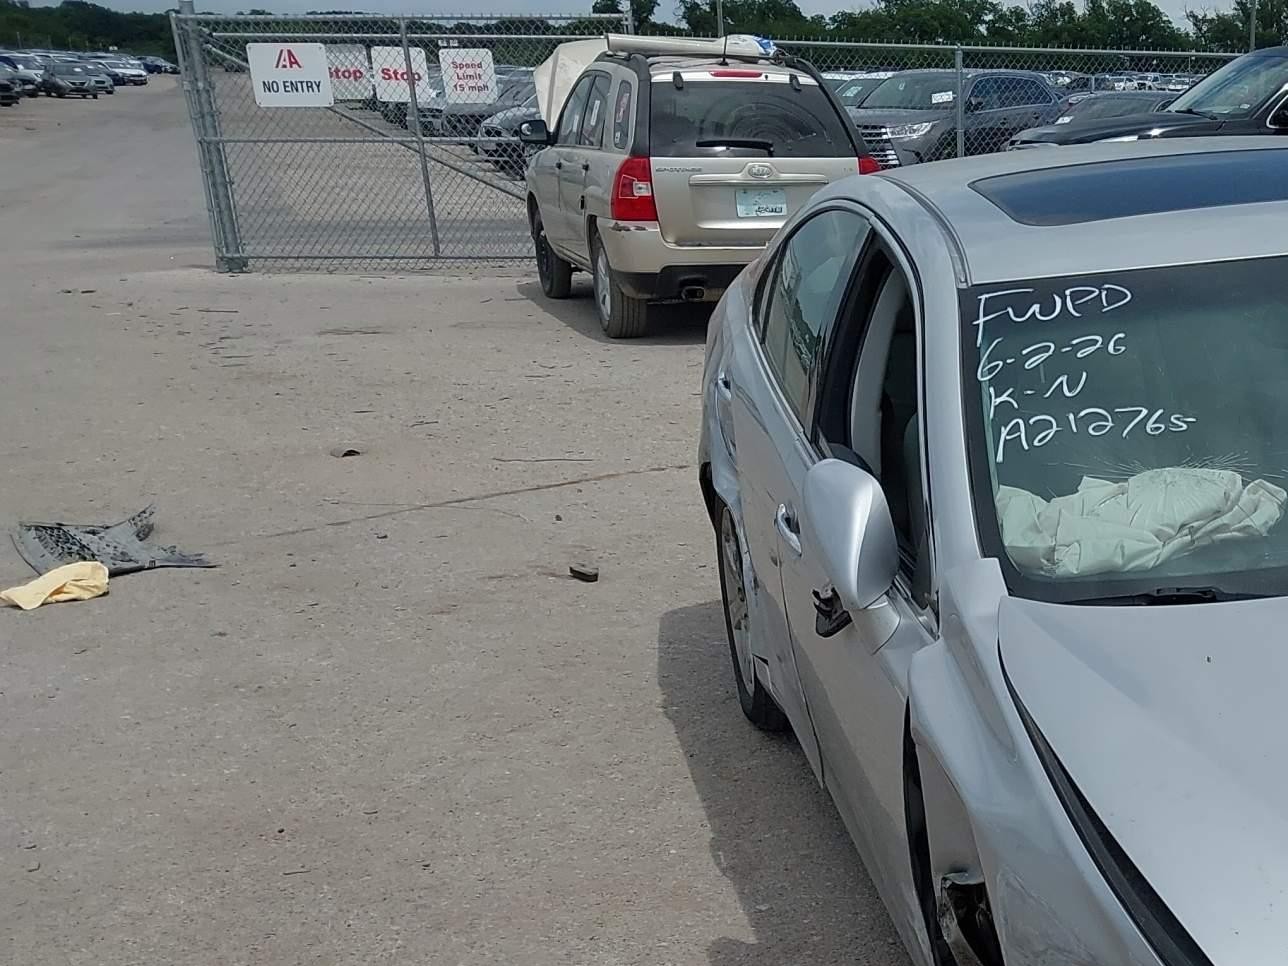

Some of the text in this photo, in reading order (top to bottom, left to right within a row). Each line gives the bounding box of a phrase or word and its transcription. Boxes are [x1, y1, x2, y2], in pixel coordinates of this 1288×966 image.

[451, 61, 483, 70] Speed
[456, 72, 481, 81] Limit
[262, 80, 322, 94] NO ENTRY
[468, 83, 489, 93] mph
[972, 284, 1132, 347] FWPD
[976, 332, 1127, 381] 6-2-26
